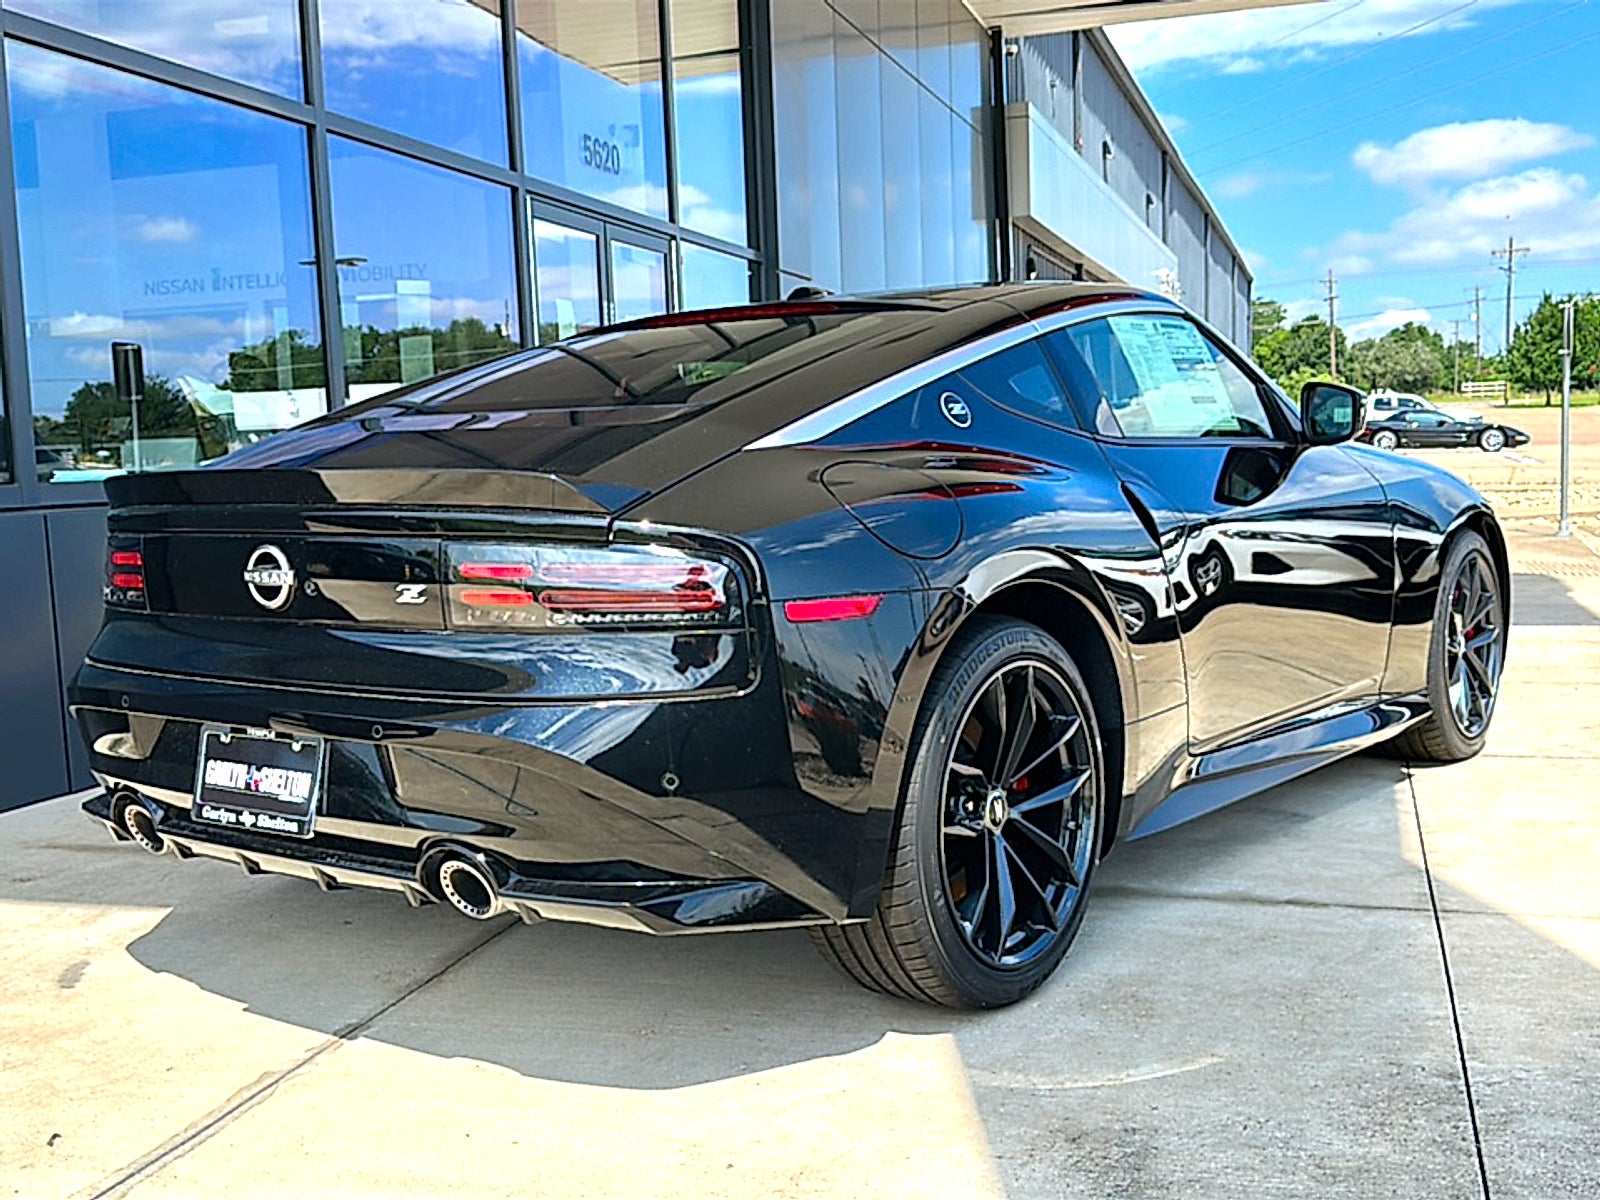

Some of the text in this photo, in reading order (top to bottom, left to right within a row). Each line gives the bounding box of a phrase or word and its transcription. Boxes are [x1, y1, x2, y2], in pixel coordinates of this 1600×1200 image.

[583, 133, 620, 175] 5620
[144, 278, 205, 295] NISSAN
[341, 263, 428, 282] MOBILITY
[244, 569, 294, 586] NISSAN
[395, 584, 428, 604] Z
